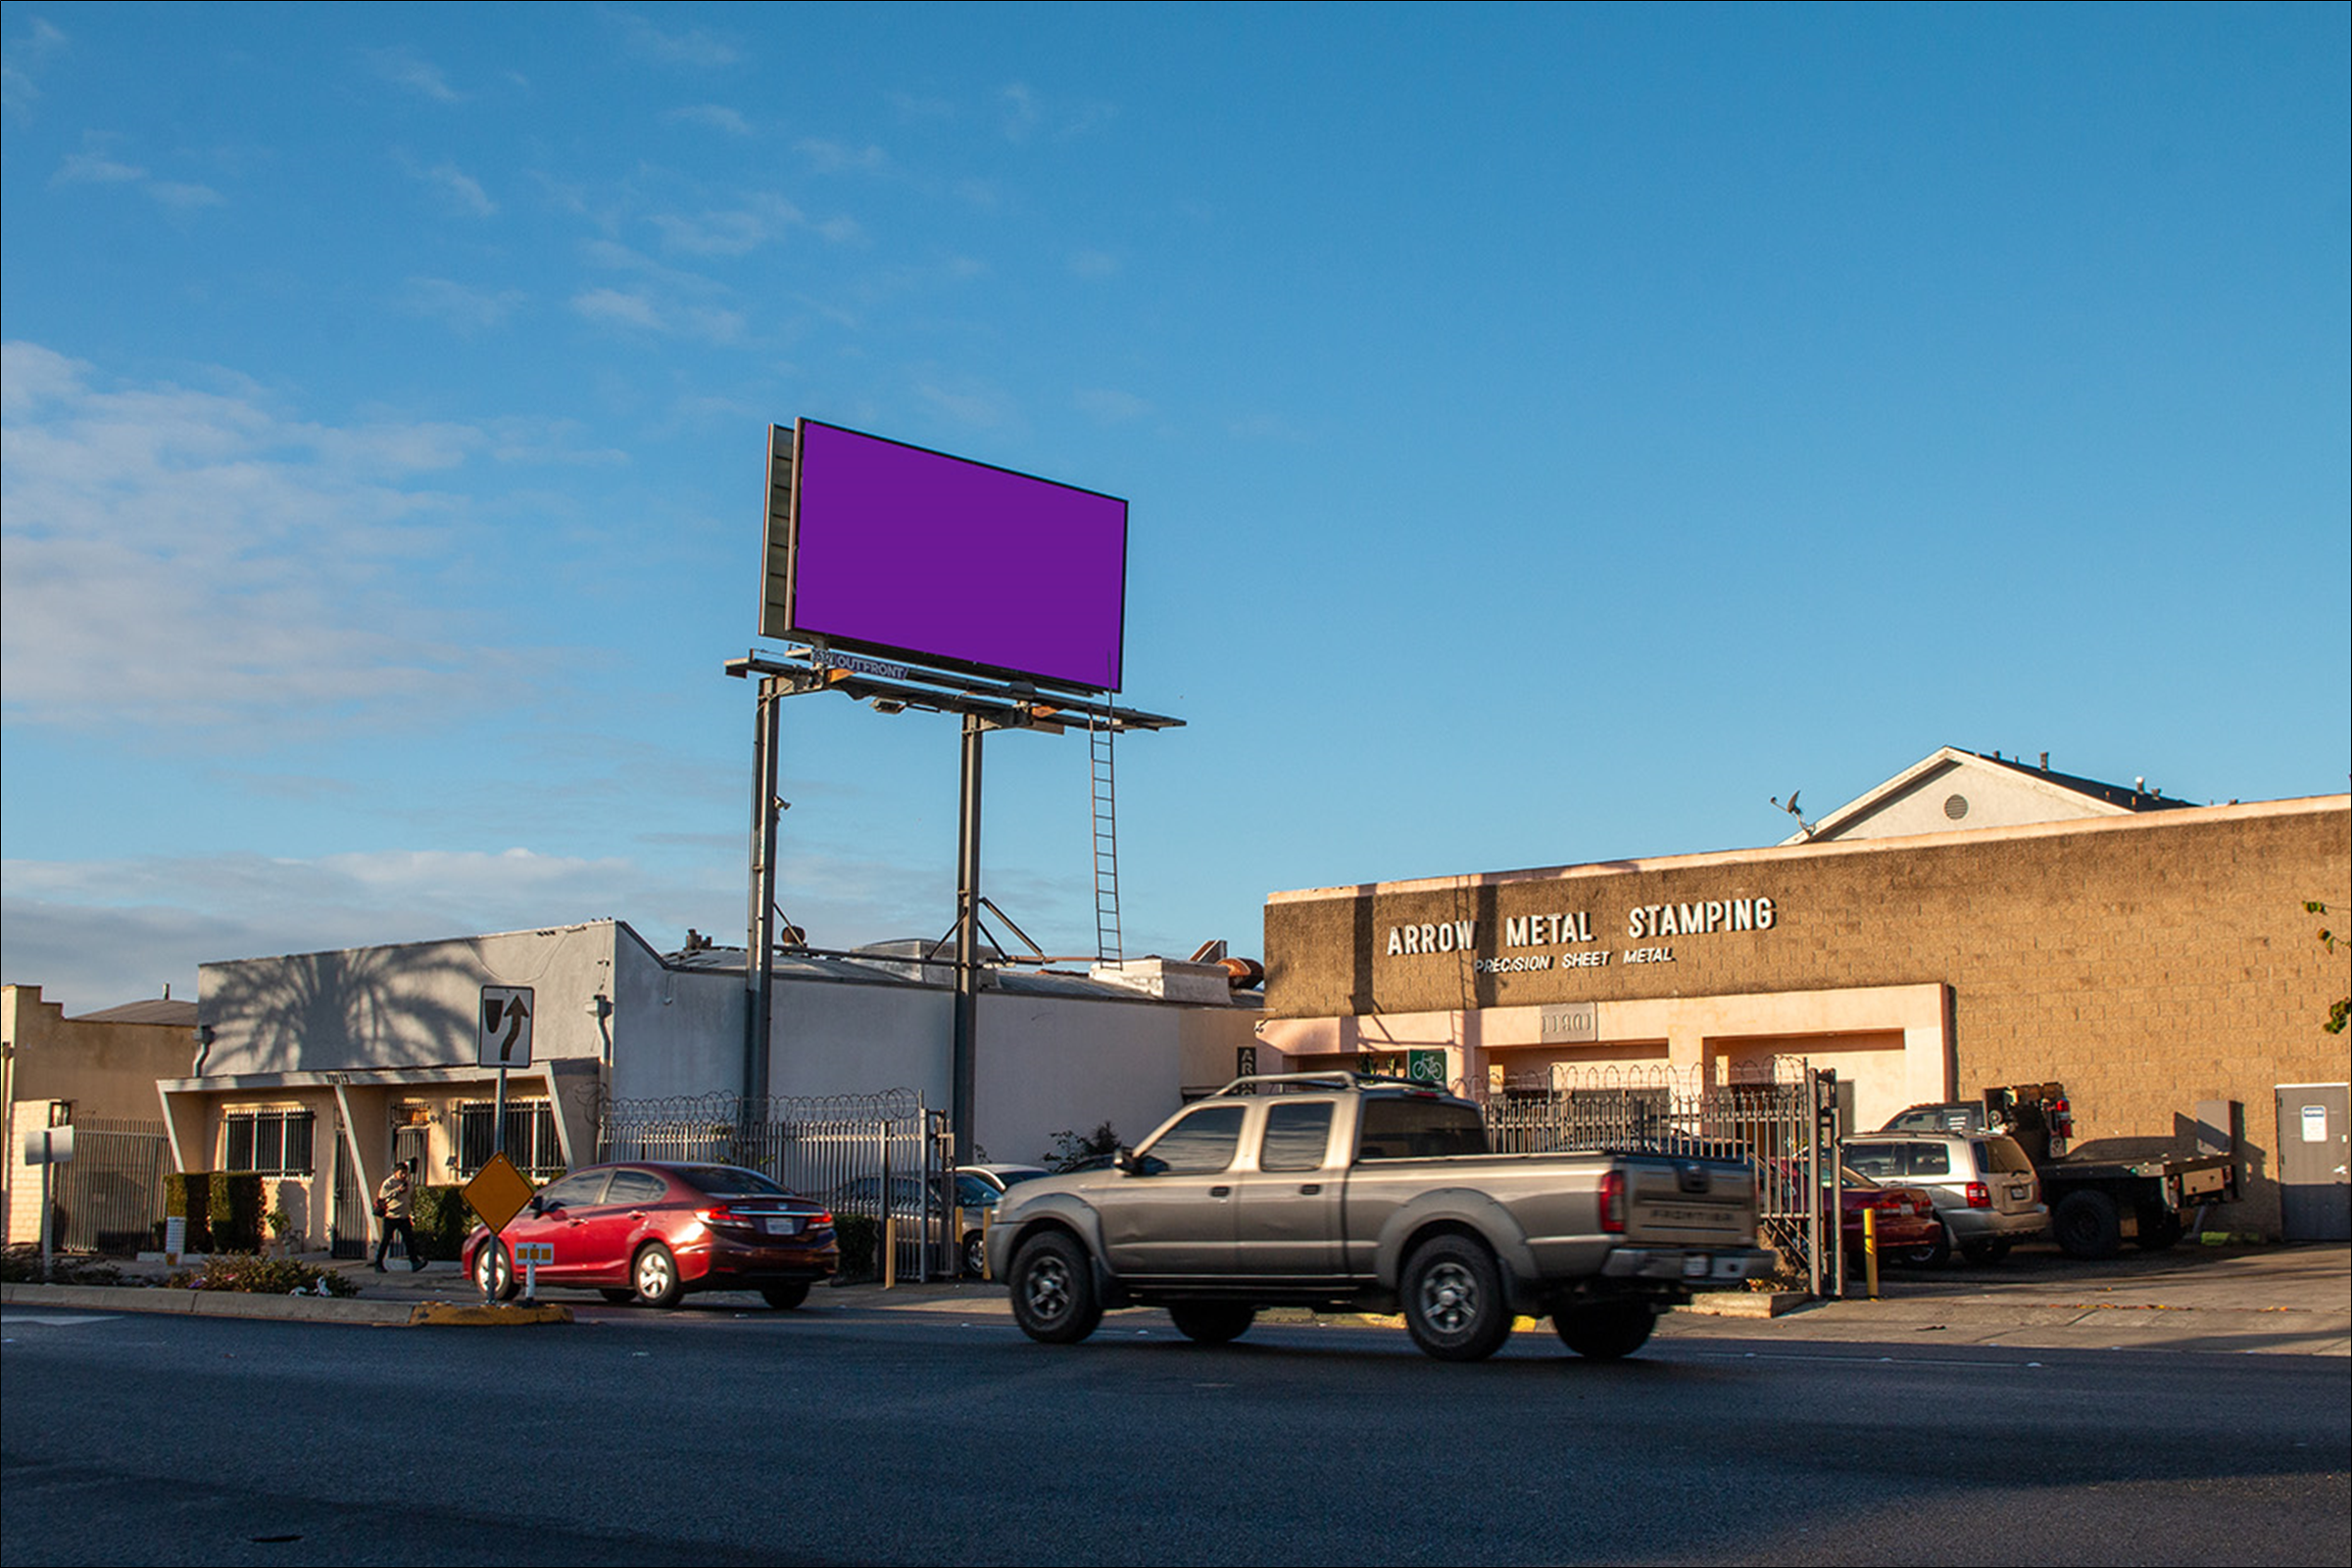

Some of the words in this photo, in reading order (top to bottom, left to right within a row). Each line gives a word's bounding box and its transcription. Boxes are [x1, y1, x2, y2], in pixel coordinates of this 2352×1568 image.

[1387, 919, 1477, 956] ARROW
[1506, 910, 1595, 948] METAL
[1628, 897, 1775, 938] STAMPING
[1474, 955, 1551, 973] PRECISION
[1561, 951, 1611, 968] SHEET
[1623, 947, 1674, 964] METAL
